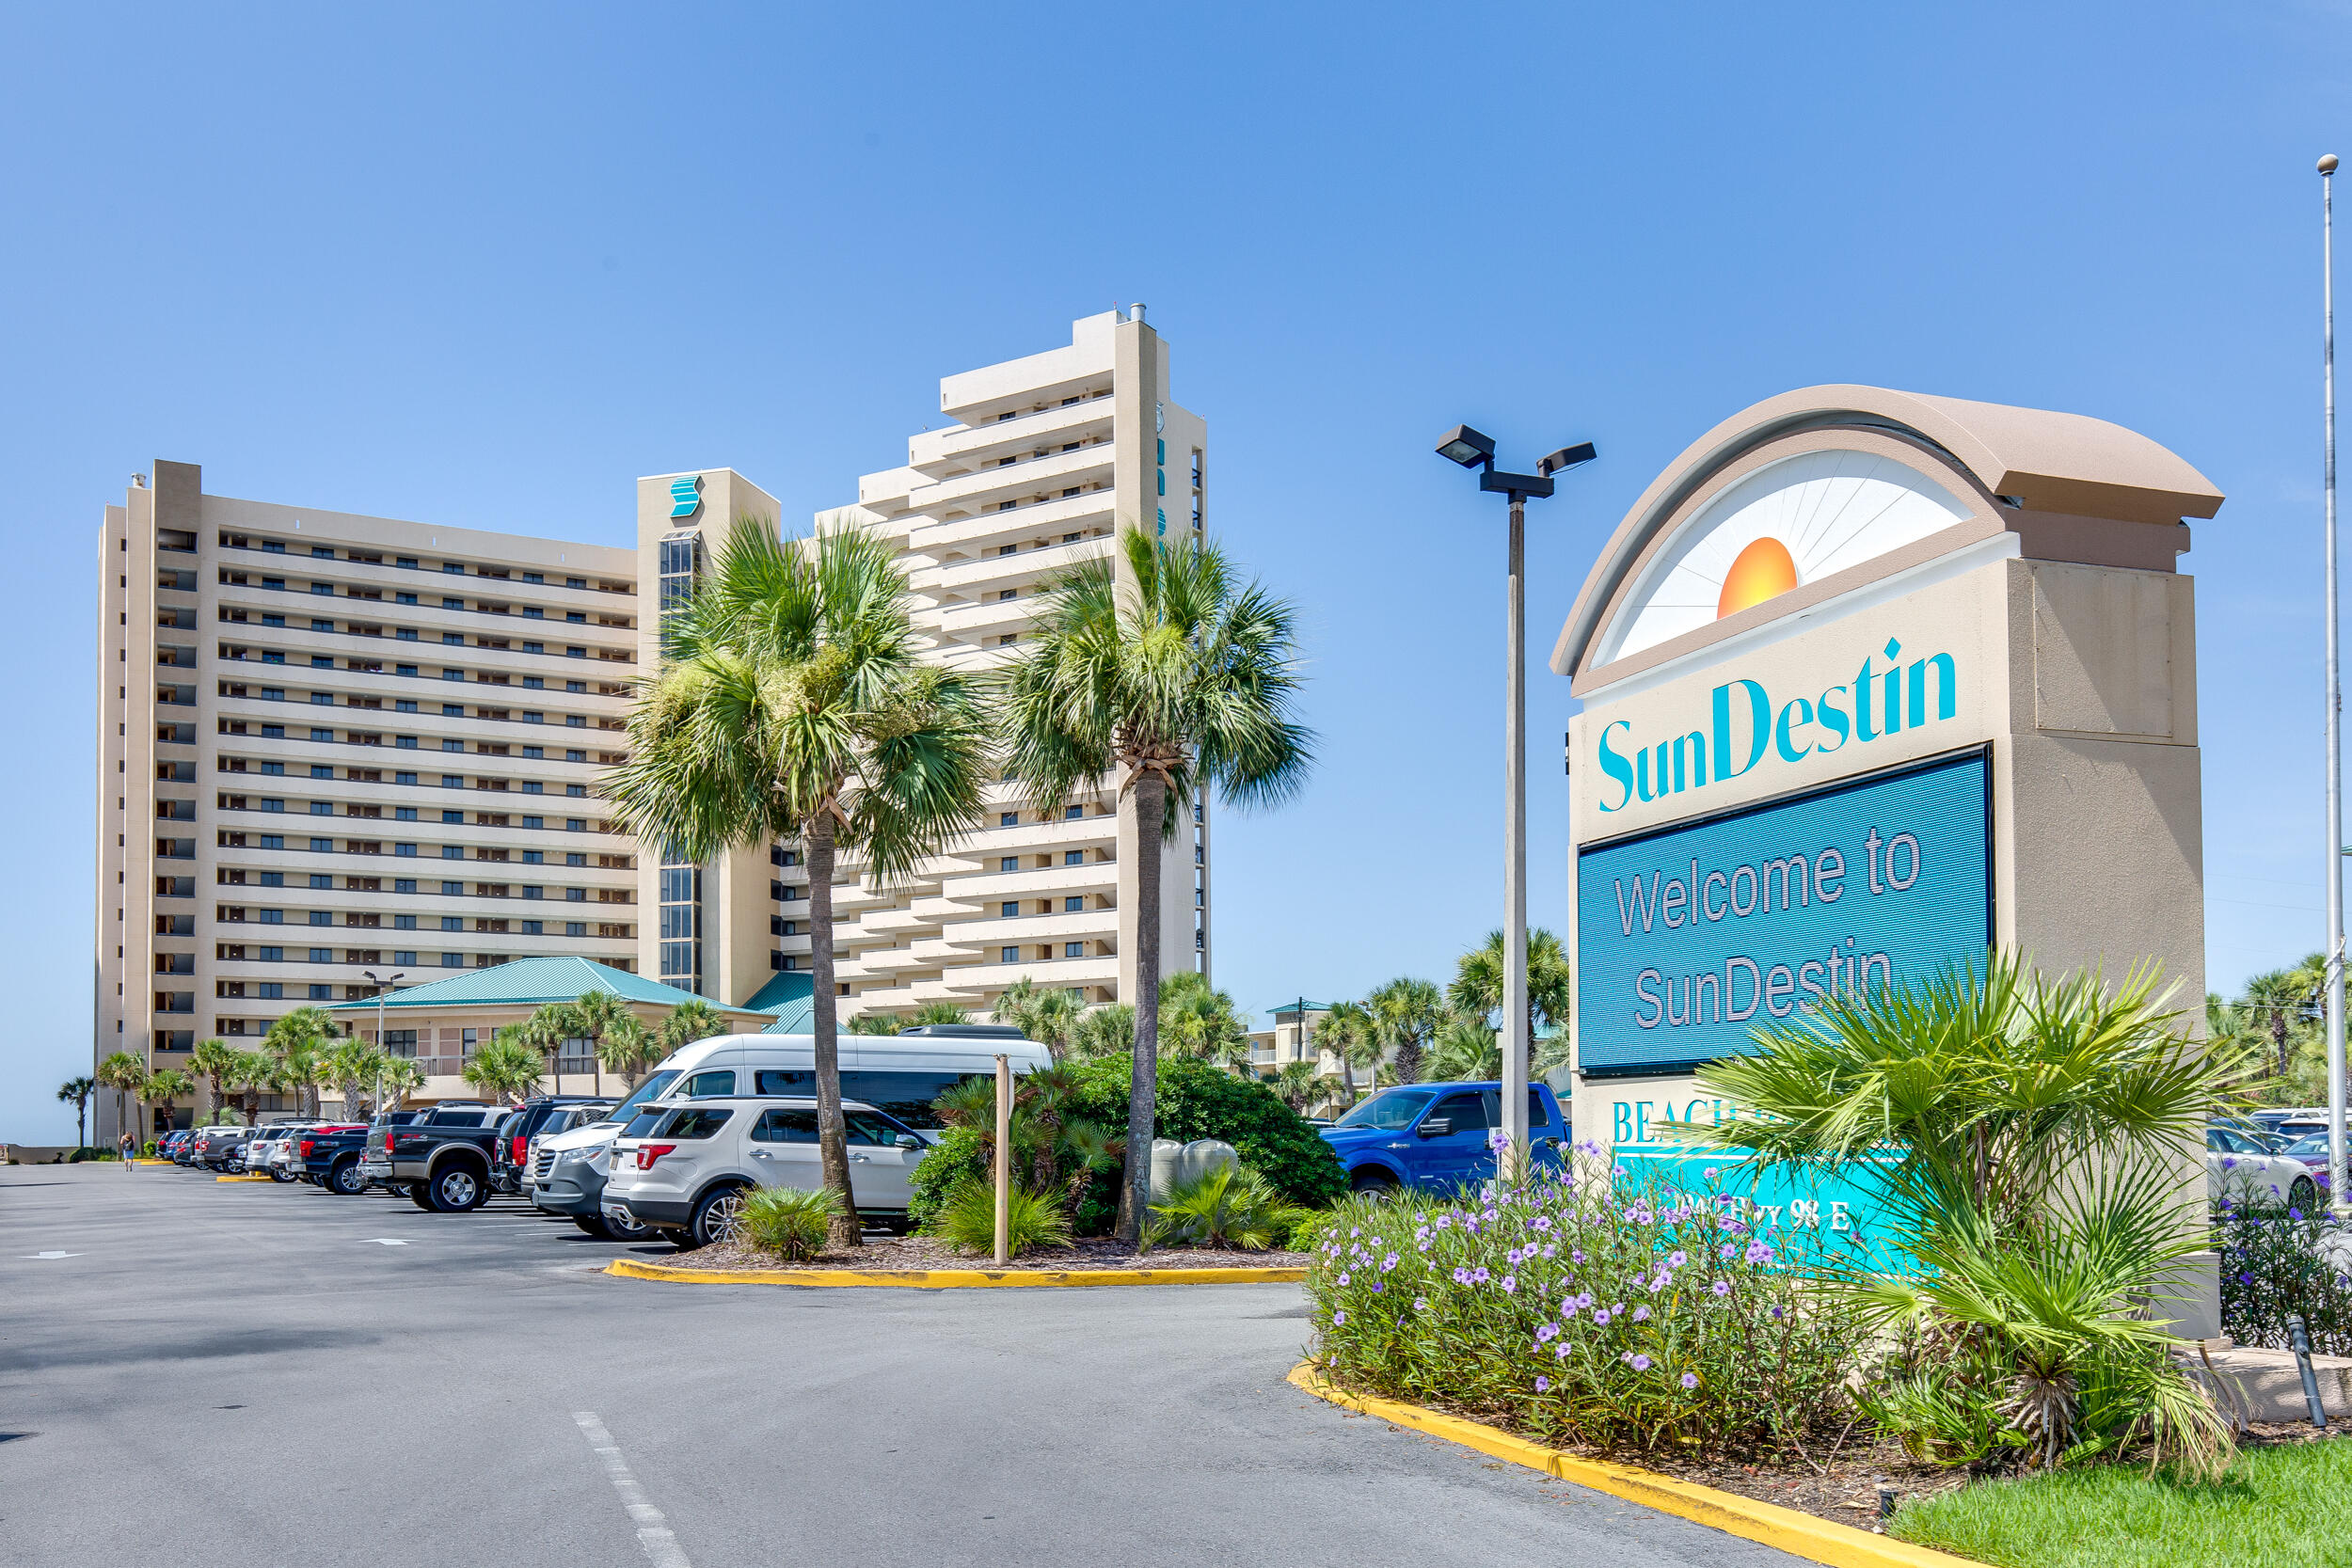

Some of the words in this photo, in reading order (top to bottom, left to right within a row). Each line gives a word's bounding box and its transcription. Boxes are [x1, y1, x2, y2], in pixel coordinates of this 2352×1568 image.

[1598, 637, 1956, 813] SunDestin
[1614, 846, 1846, 937] Welcome
[1865, 826, 1921, 895] to
[1634, 935, 1893, 1029] SunDestin
[1789, 1197, 1820, 1229] 98
[1830, 1200, 1851, 1230] E
